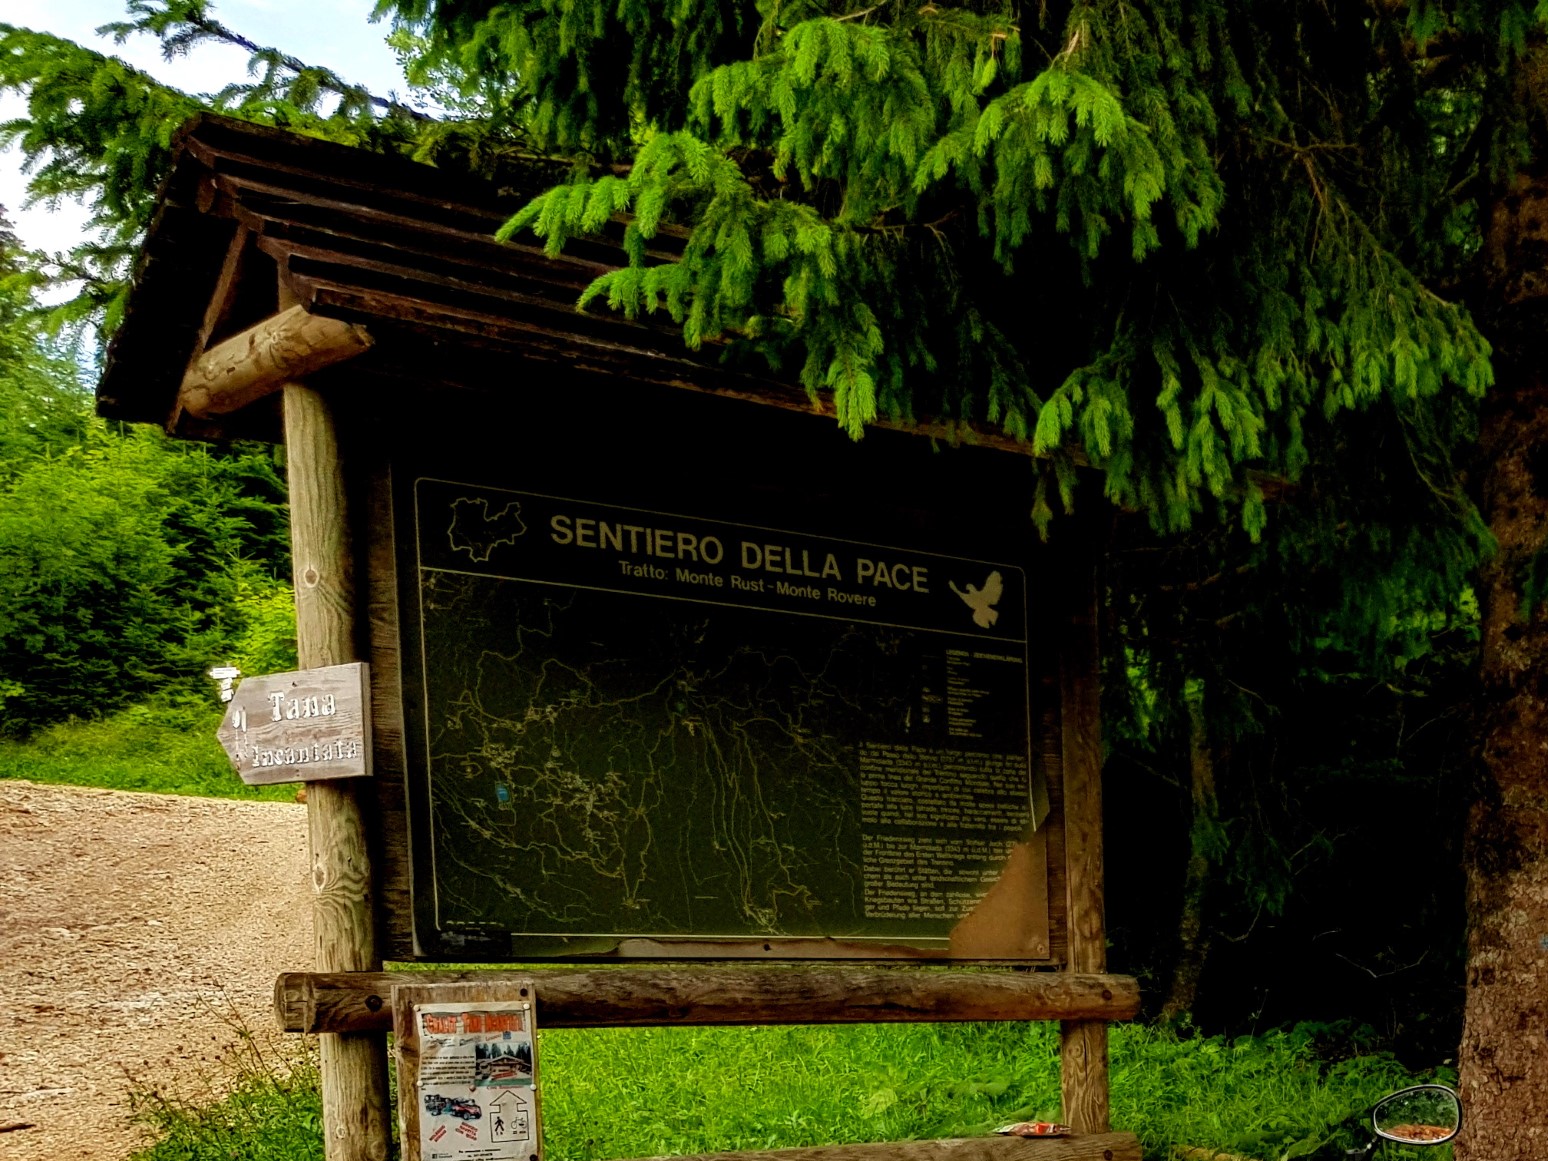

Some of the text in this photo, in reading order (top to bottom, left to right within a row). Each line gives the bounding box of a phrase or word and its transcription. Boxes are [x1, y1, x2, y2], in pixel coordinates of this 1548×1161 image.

[549, 514, 930, 593] SENTIERO DELLA PACE
[618, 559, 669, 583] Tratto:
[675, 567, 724, 589] Monte
[827, 588, 877, 608] Rovere
[267, 690, 337, 722] Tana
[251, 738, 358, 769] Incantata
